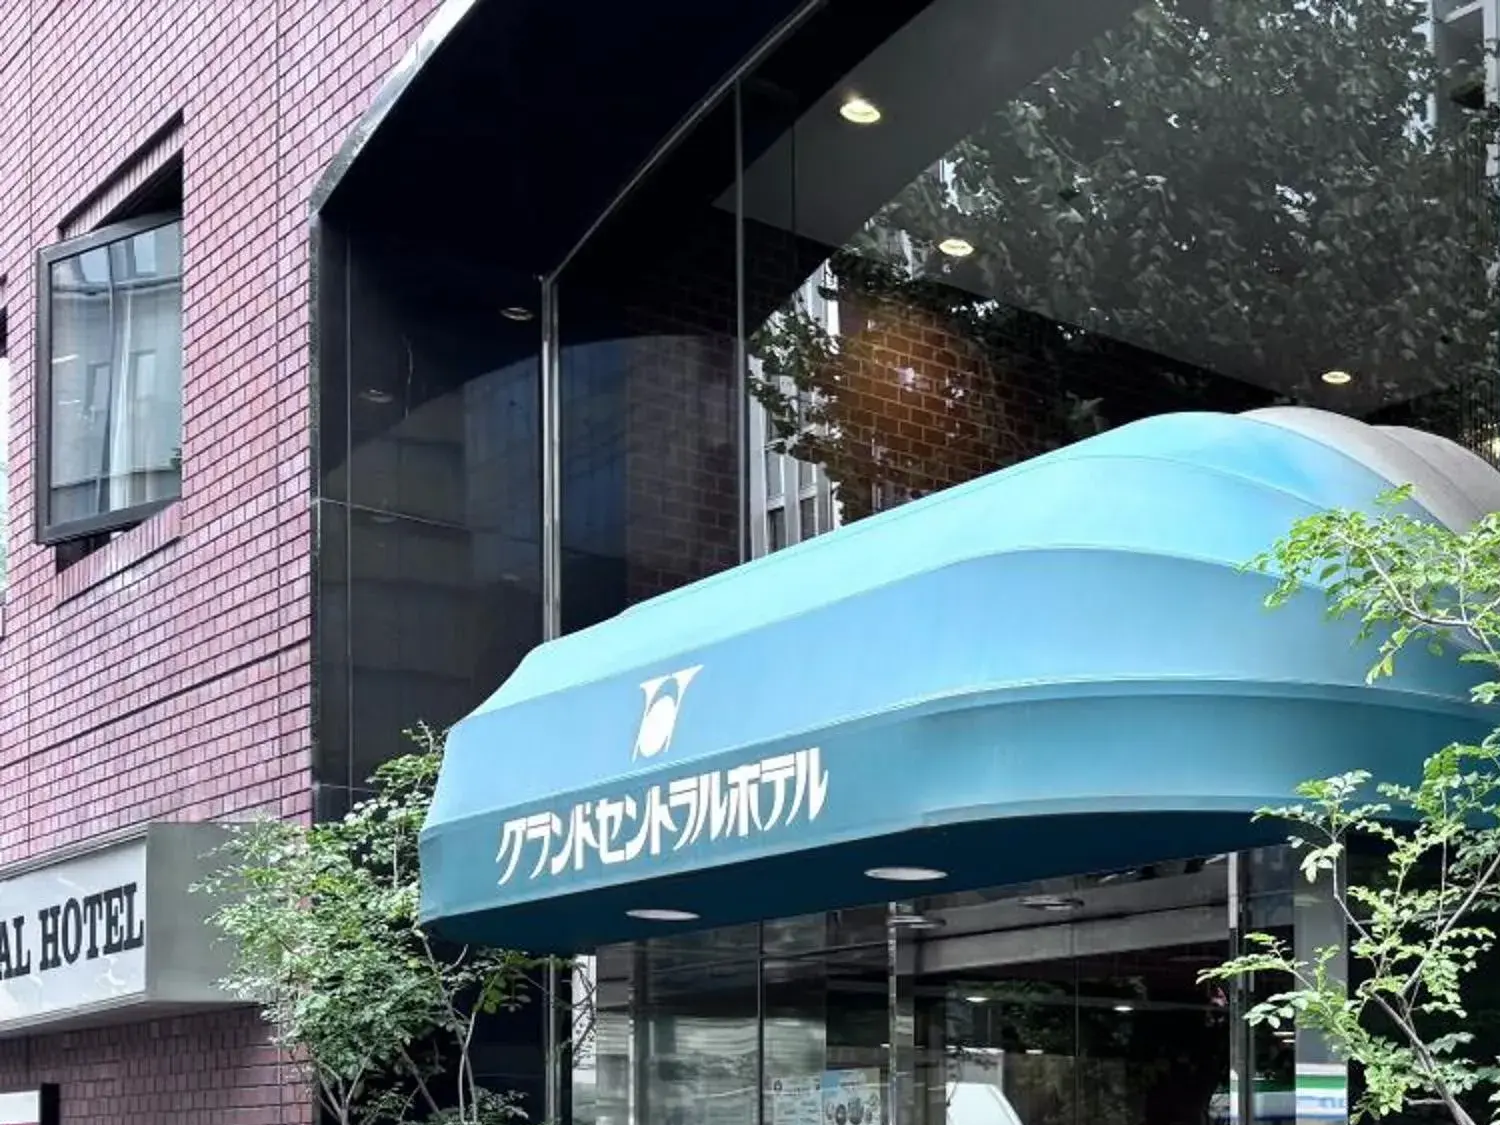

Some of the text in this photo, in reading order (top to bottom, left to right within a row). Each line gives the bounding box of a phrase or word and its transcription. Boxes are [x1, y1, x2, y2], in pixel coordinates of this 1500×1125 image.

[496, 747, 829, 885] グランドセントラルホテル
[38, 882, 144, 971] HOTEL
